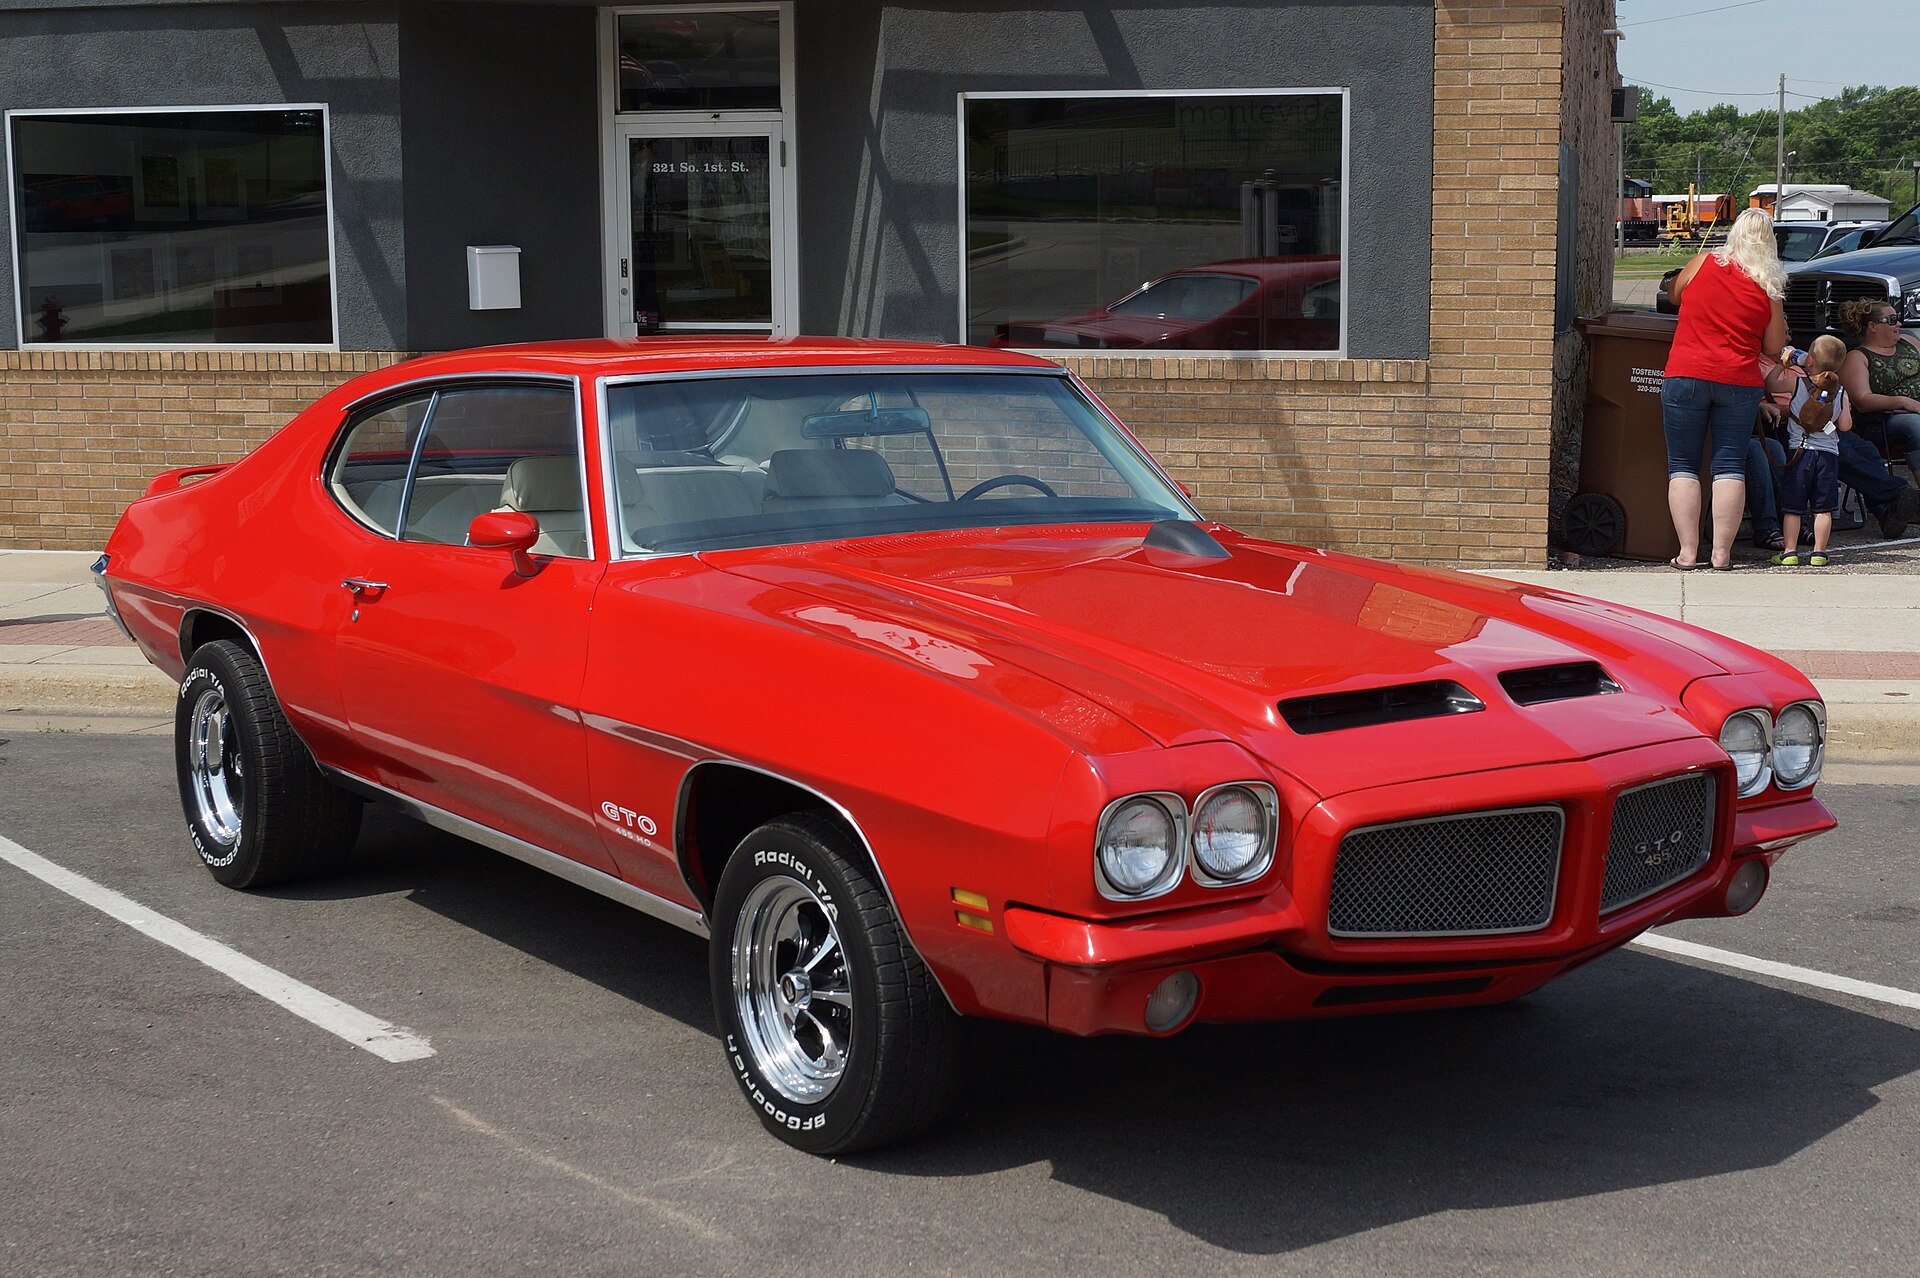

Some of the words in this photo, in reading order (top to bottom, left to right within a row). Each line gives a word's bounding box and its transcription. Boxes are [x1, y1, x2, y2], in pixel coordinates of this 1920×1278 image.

[653, 162, 676, 173] 321
[680, 162, 699, 173] So.
[703, 162, 728, 173] 1st.
[731, 161, 750, 173] St.
[1630, 375, 1664, 385] MONTEVID
[180, 667, 208, 699] Radial
[601, 801, 657, 836] GTO
[189, 823, 242, 867] BFGoodrich
[1634, 830, 1681, 854] GTO
[1644, 849, 1670, 866] 455
[754, 850, 812, 881] Radial
[816, 879, 839, 923] T/A
[727, 1034, 826, 1131] BFGoodrich
